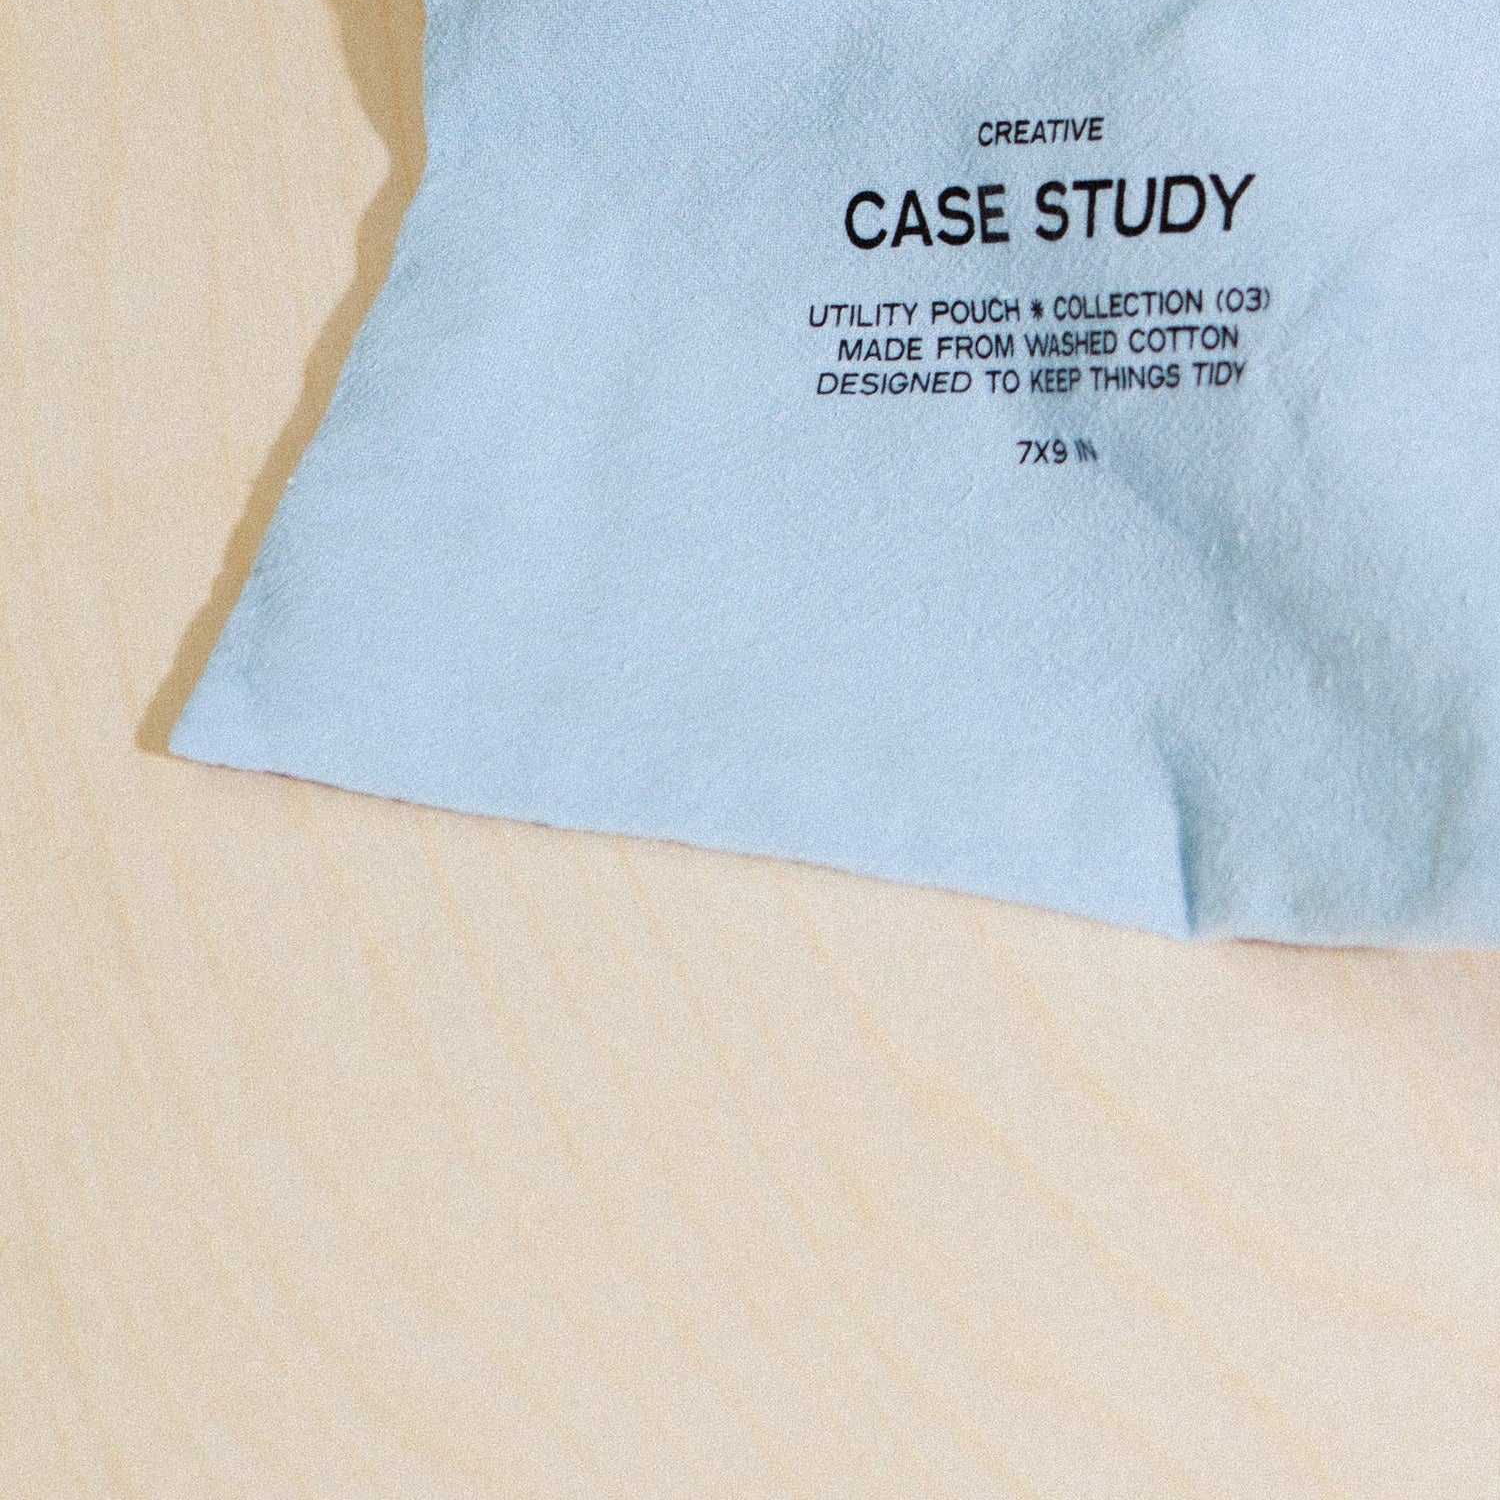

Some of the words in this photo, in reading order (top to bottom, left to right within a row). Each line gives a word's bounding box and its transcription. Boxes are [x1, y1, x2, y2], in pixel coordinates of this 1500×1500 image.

[977, 116, 1105, 148] CREATIVE
[844, 183, 1010, 250] CASE
[1035, 173, 1257, 242] STUDY
[807, 301, 919, 329] UTILITY
[930, 297, 1021, 325] POUCH
[1053, 289, 1204, 321] COLLECTION
[837, 337, 924, 362] MADE
[936, 334, 1014, 360] FROM
[1024, 331, 1118, 357] WASHED
[1128, 325, 1240, 353] COTTON
[816, 371, 972, 397] DESIGNED
[984, 369, 1021, 395] TO
[1029, 366, 1082, 394] KEEP
[1088, 363, 1181, 392] THINGS
[1192, 361, 1248, 387] TIDY
[1015, 439, 1068, 465] 7X9
